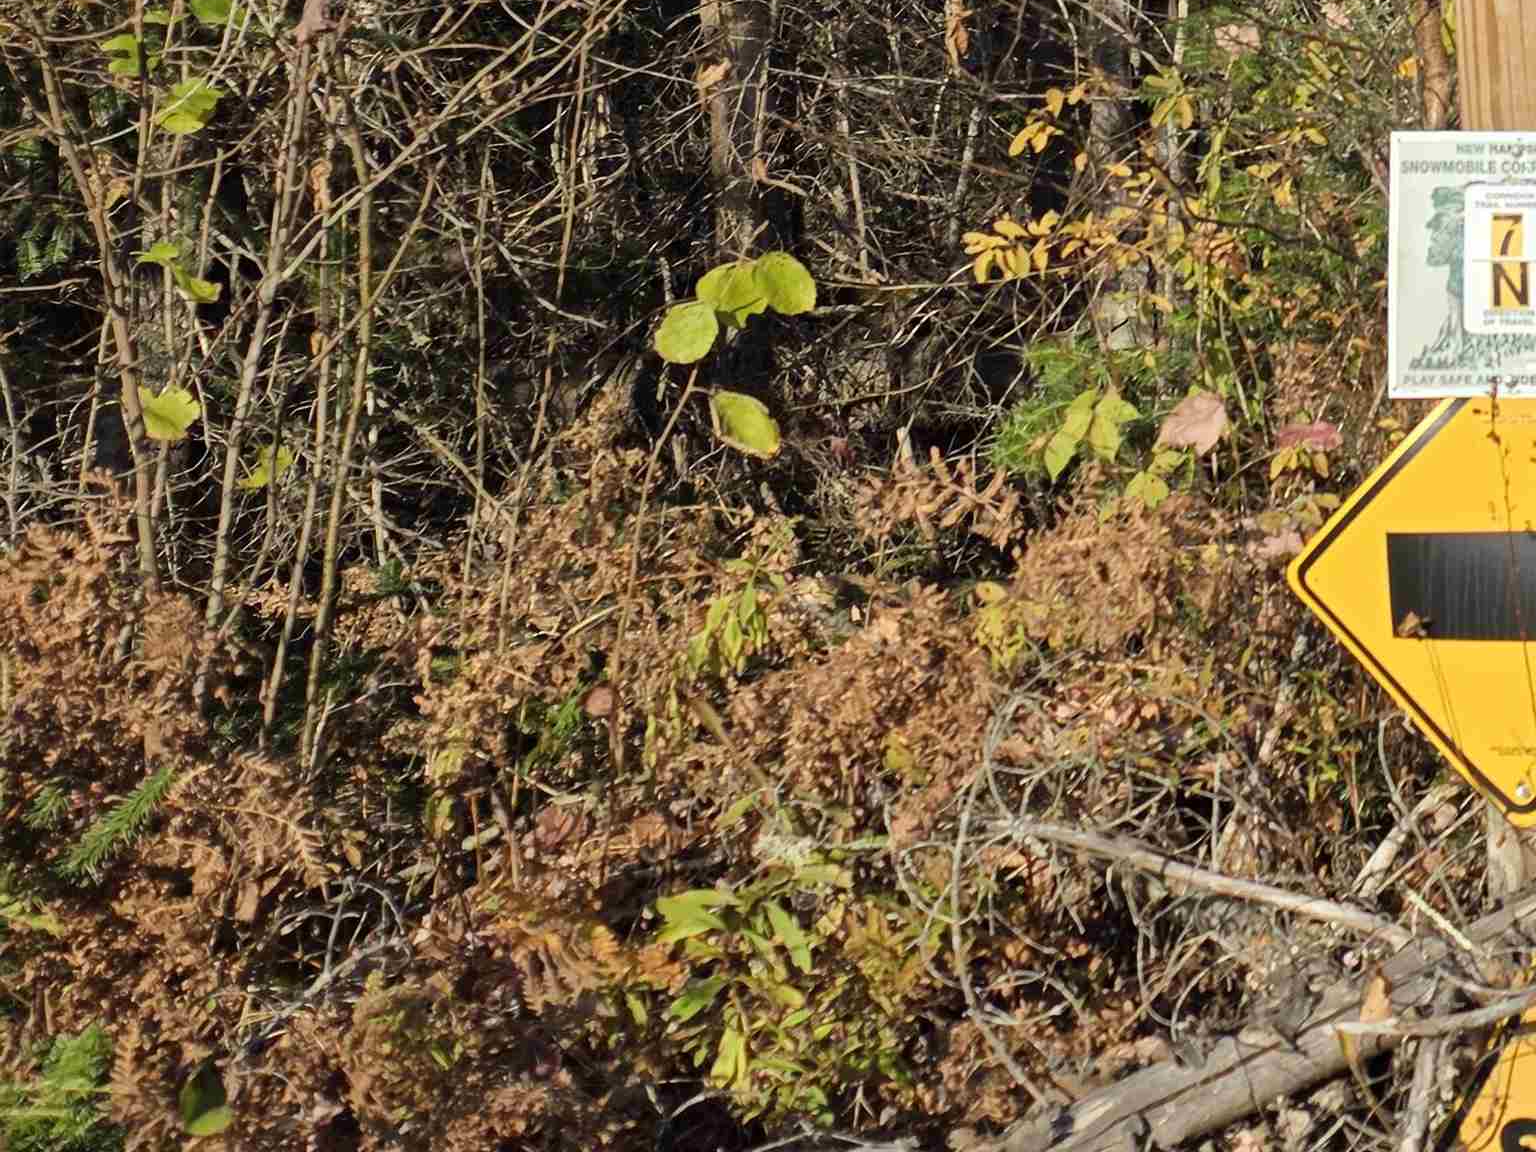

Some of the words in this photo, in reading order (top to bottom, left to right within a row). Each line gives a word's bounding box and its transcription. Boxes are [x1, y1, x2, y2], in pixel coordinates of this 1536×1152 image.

[1456, 143, 1484, 153] NEW
[1401, 160, 1496, 174] SNOWMOBILE
[1492, 213, 1522, 256] 7
[1493, 261, 1529, 307] N
[1403, 375, 1435, 385] PLAY
[1440, 375, 1472, 385] SAFE
